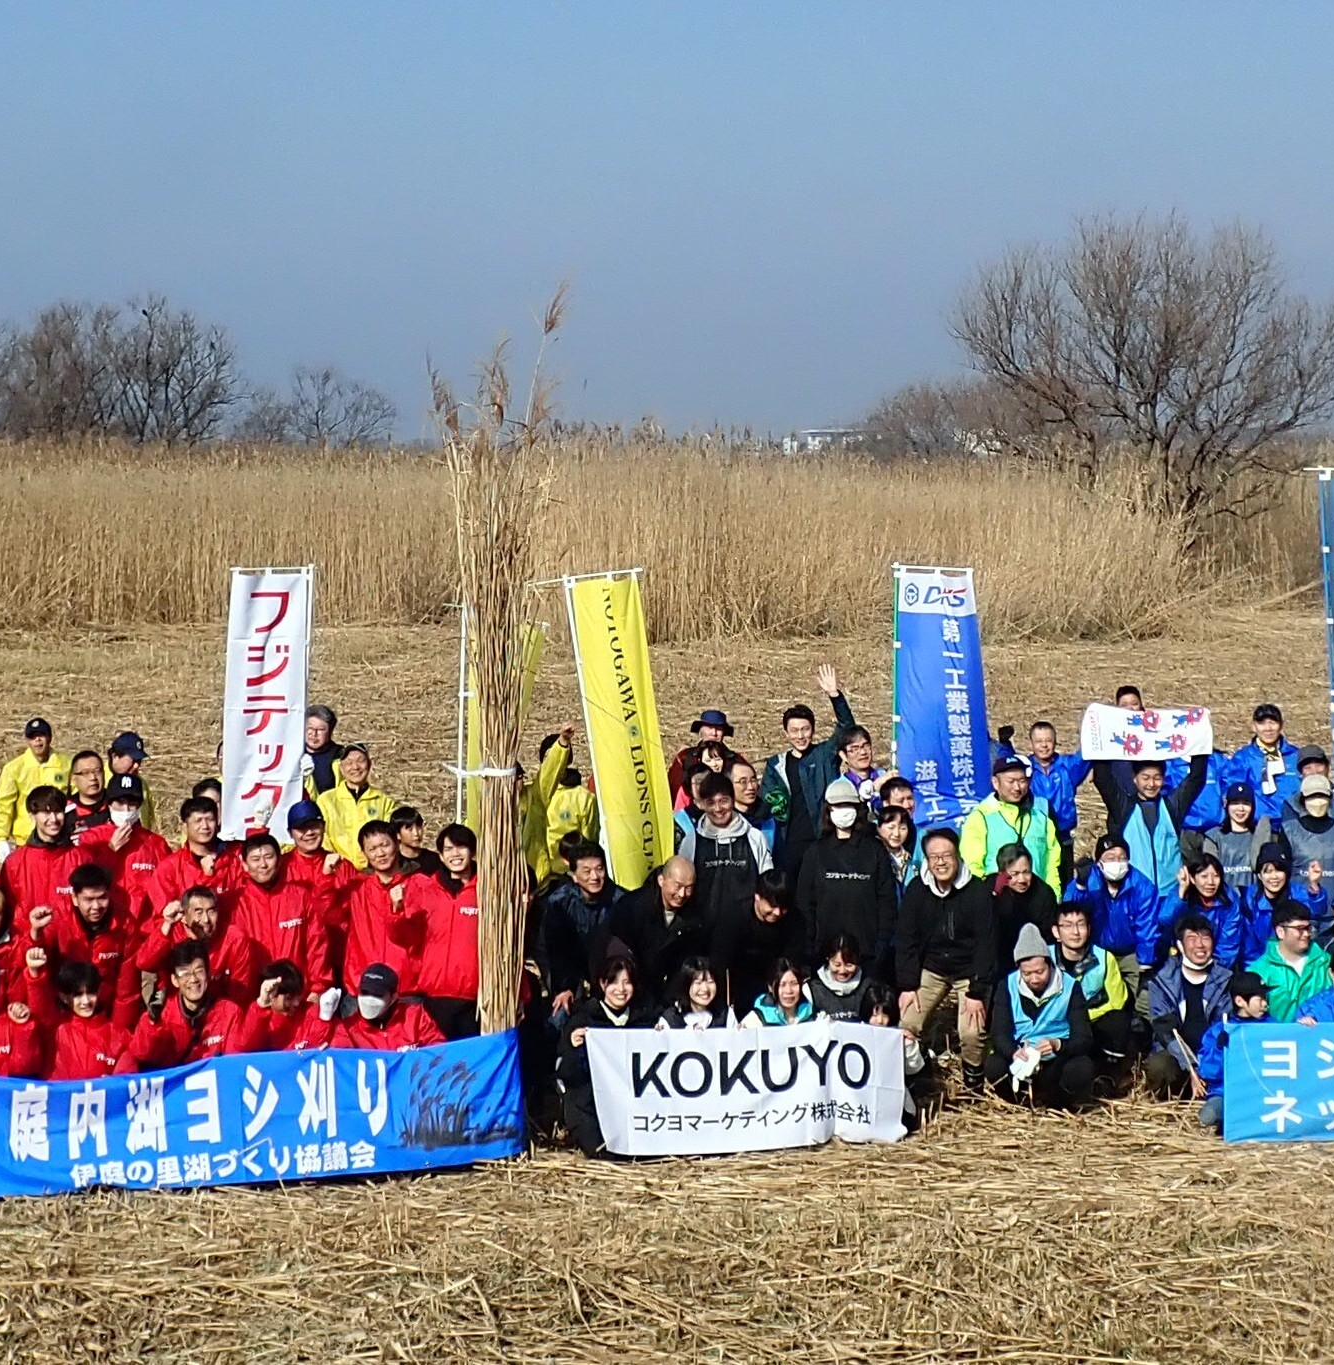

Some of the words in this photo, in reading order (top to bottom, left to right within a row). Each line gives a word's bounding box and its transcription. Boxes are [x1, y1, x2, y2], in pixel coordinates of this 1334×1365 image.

[241, 591, 290, 824] フジテック
[630, 744, 652, 815] LIONS
[631, 1039, 872, 1099] KOKUYO
[633, 1101, 872, 1133] コクヨマーケティング株式会社
[70, 1138, 377, 1189] 伊庭の里湖づくり協議会
